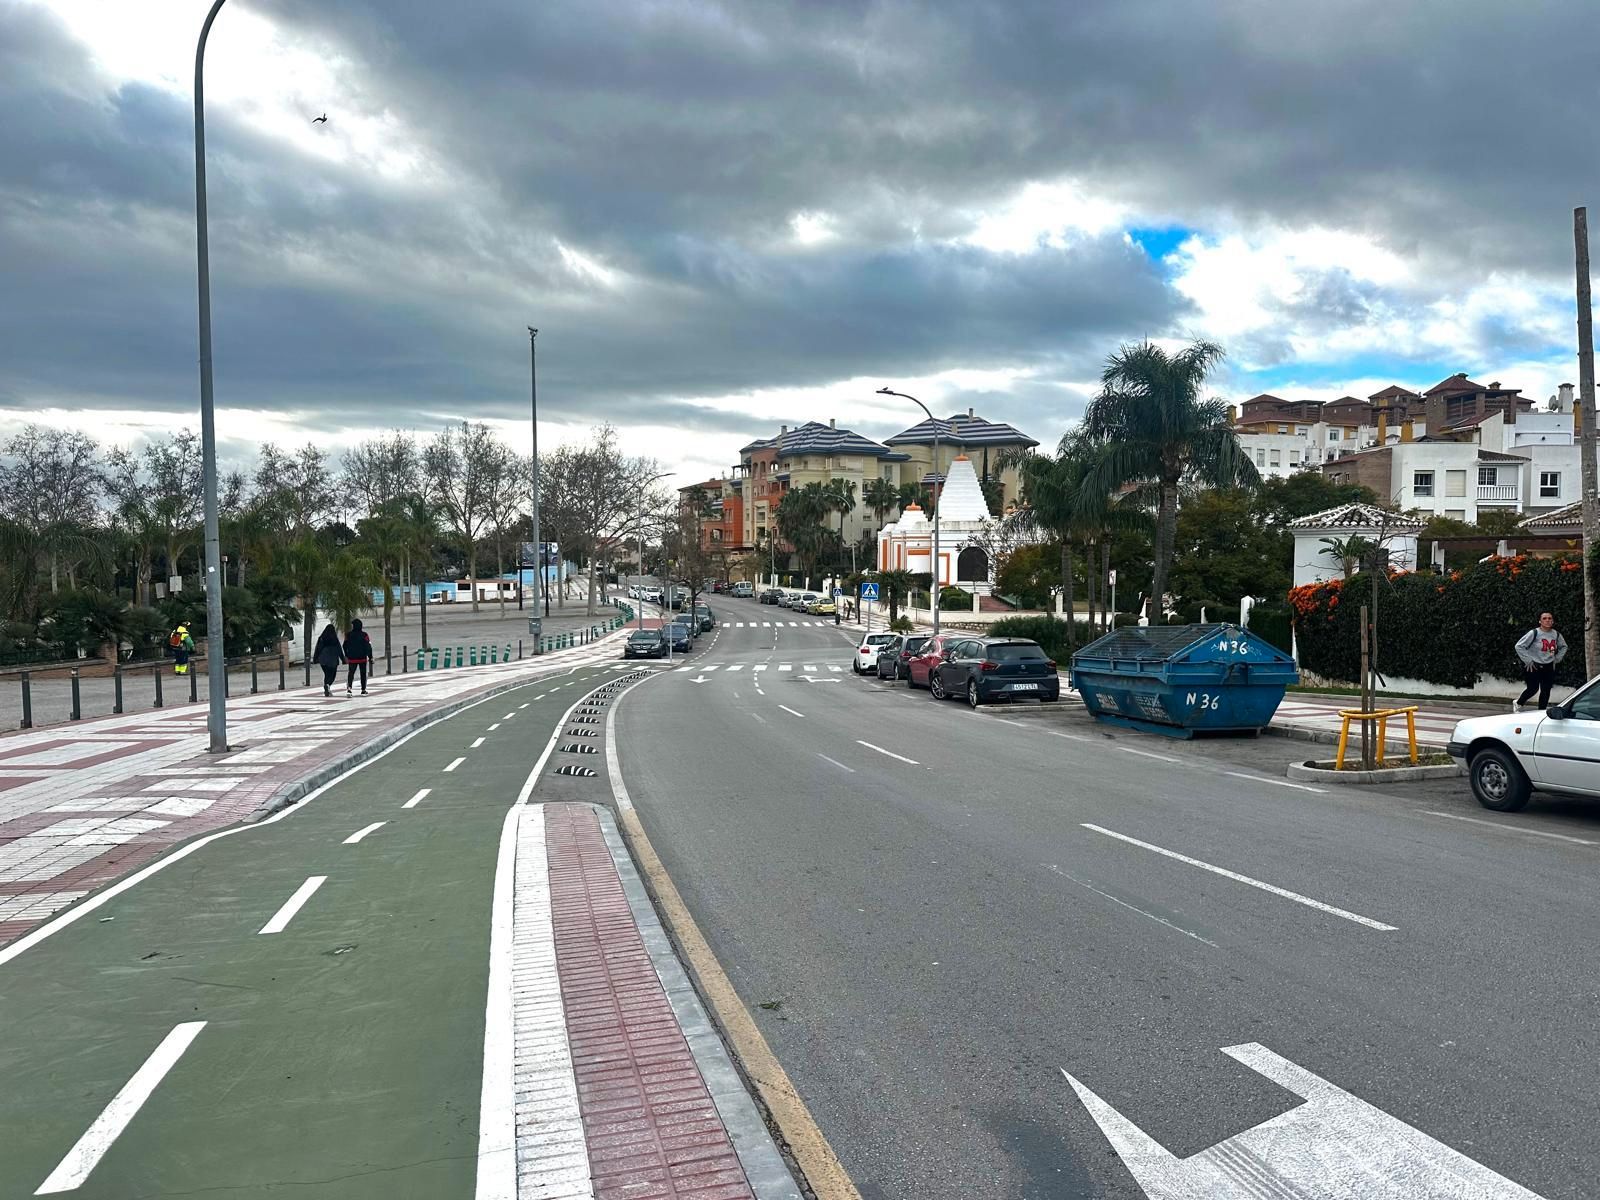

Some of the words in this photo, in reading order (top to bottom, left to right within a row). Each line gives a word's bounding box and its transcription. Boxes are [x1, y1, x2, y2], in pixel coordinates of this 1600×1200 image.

[1219, 640, 1228, 652] N
[1231, 641, 1248, 655] 36
[1541, 639, 1557, 652] M
[1186, 692, 1196, 706] N
[1200, 693, 1220, 710] 36
